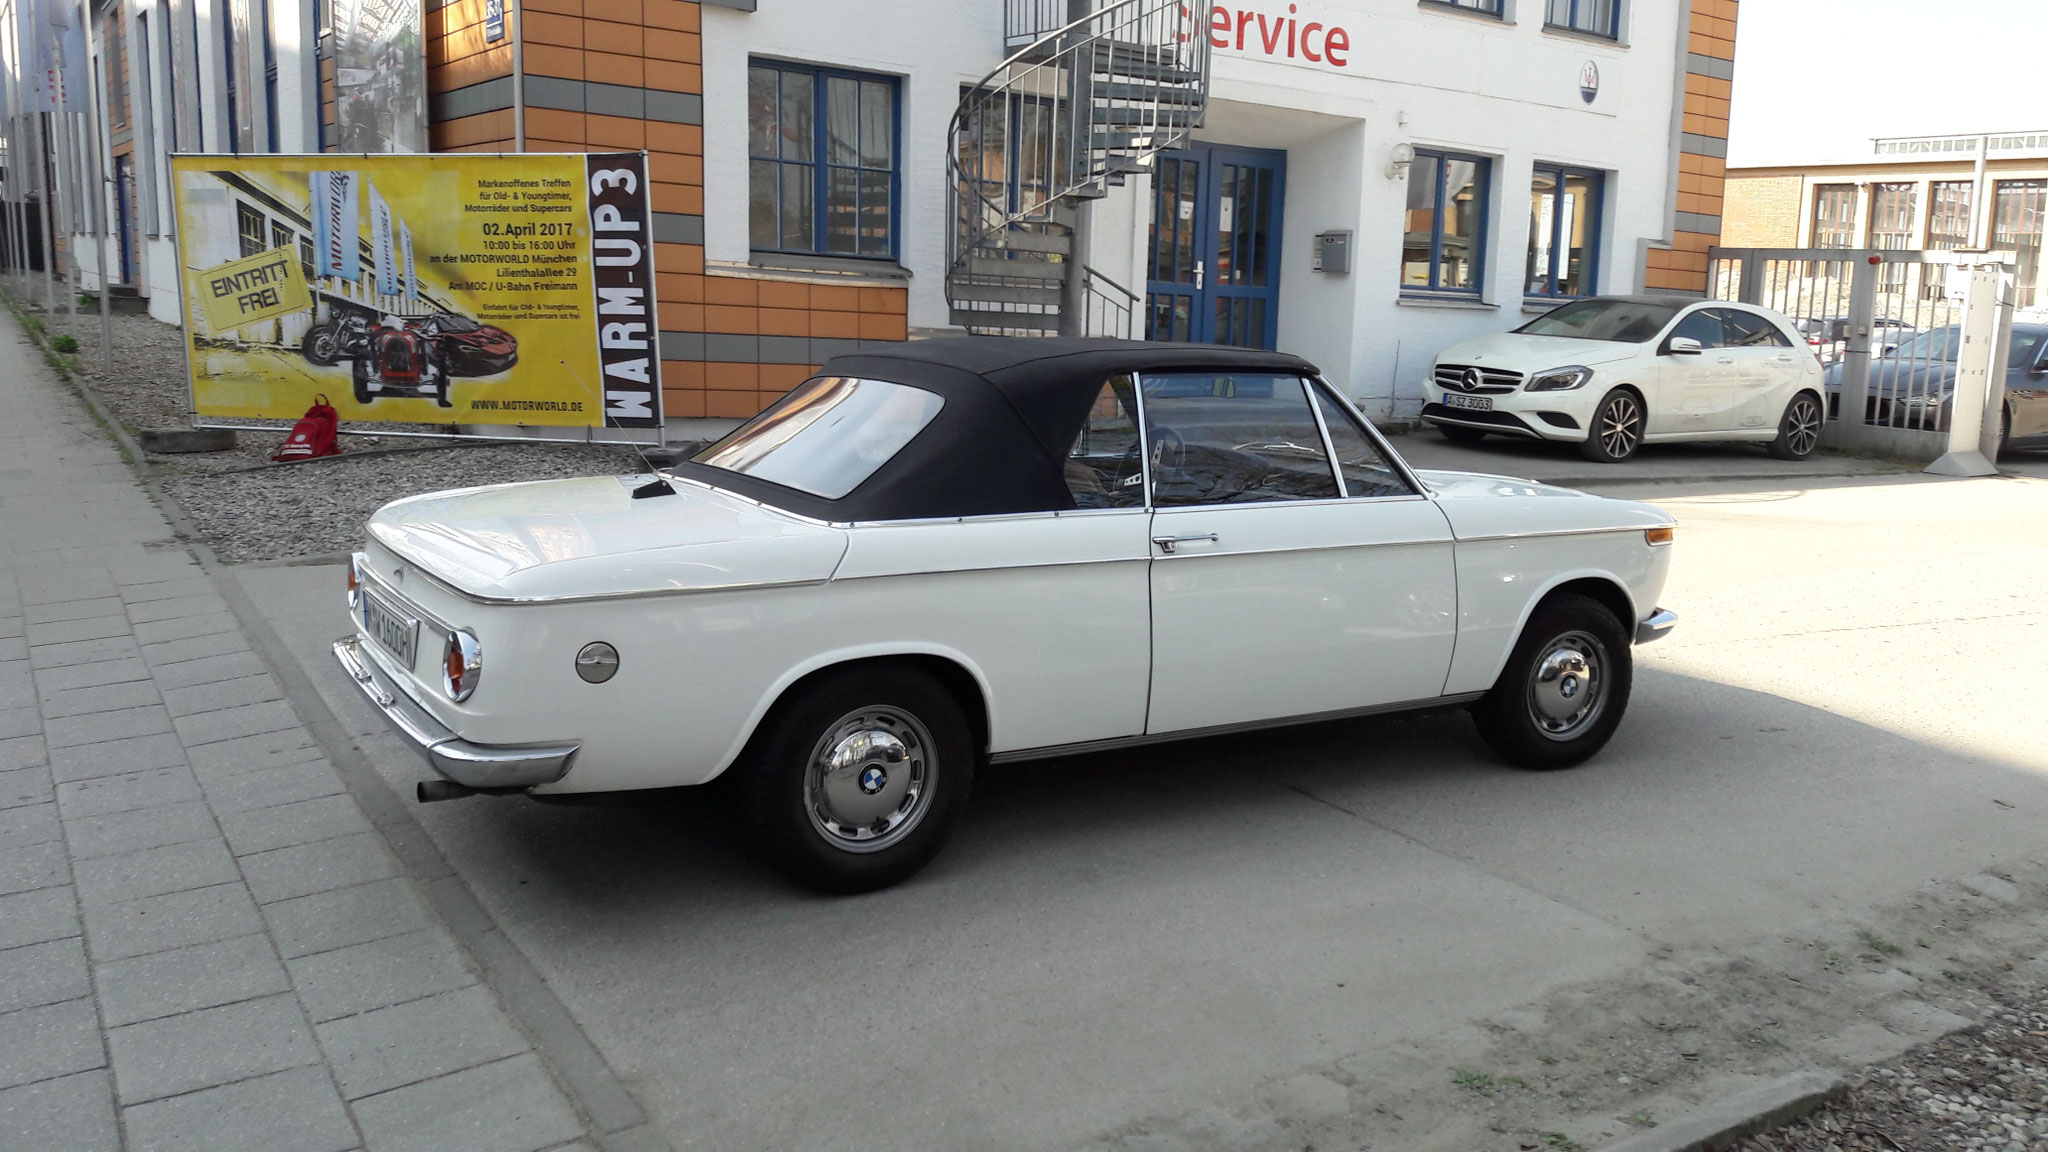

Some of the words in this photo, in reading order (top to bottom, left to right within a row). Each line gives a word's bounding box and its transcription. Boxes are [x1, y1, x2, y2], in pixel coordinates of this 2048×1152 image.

[478, 178, 539, 188] Markenoffenes
[541, 178, 571, 188] Treffen
[479, 191, 492, 200] für
[493, 191, 511, 200] Old-
[513, 192, 519, 200] &
[521, 191, 572, 202] Youngtimer,
[464, 204, 510, 213] Motorräder
[512, 204, 528, 212] und
[530, 203, 572, 214] Supercars
[483, 222, 536, 239] 02.April
[539, 222, 573, 236] 2017
[483, 240, 510, 250] 10:00
[512, 240, 526, 250] bis
[529, 240, 554, 250] 16:00
[557, 240, 576, 249] Uhr
[429, 255, 442, 263] an
[443, 254, 458, 263] der
[460, 254, 530, 264] MOTORWORLD
[532, 253, 578, 264] München
[496, 267, 565, 278] Lilienthalallee
[566, 267, 577, 277] 29
[210, 259, 289, 298] EINTRITT
[449, 281, 464, 291] Am
[465, 281, 487, 291] MOC
[489, 282, 493, 291] /
[495, 281, 532, 291] U-Bahn
[534, 280, 578, 291] Freimann
[237, 287, 281, 314] FREI
[471, 400, 583, 412] WWW.MOTORWORLD.DE
